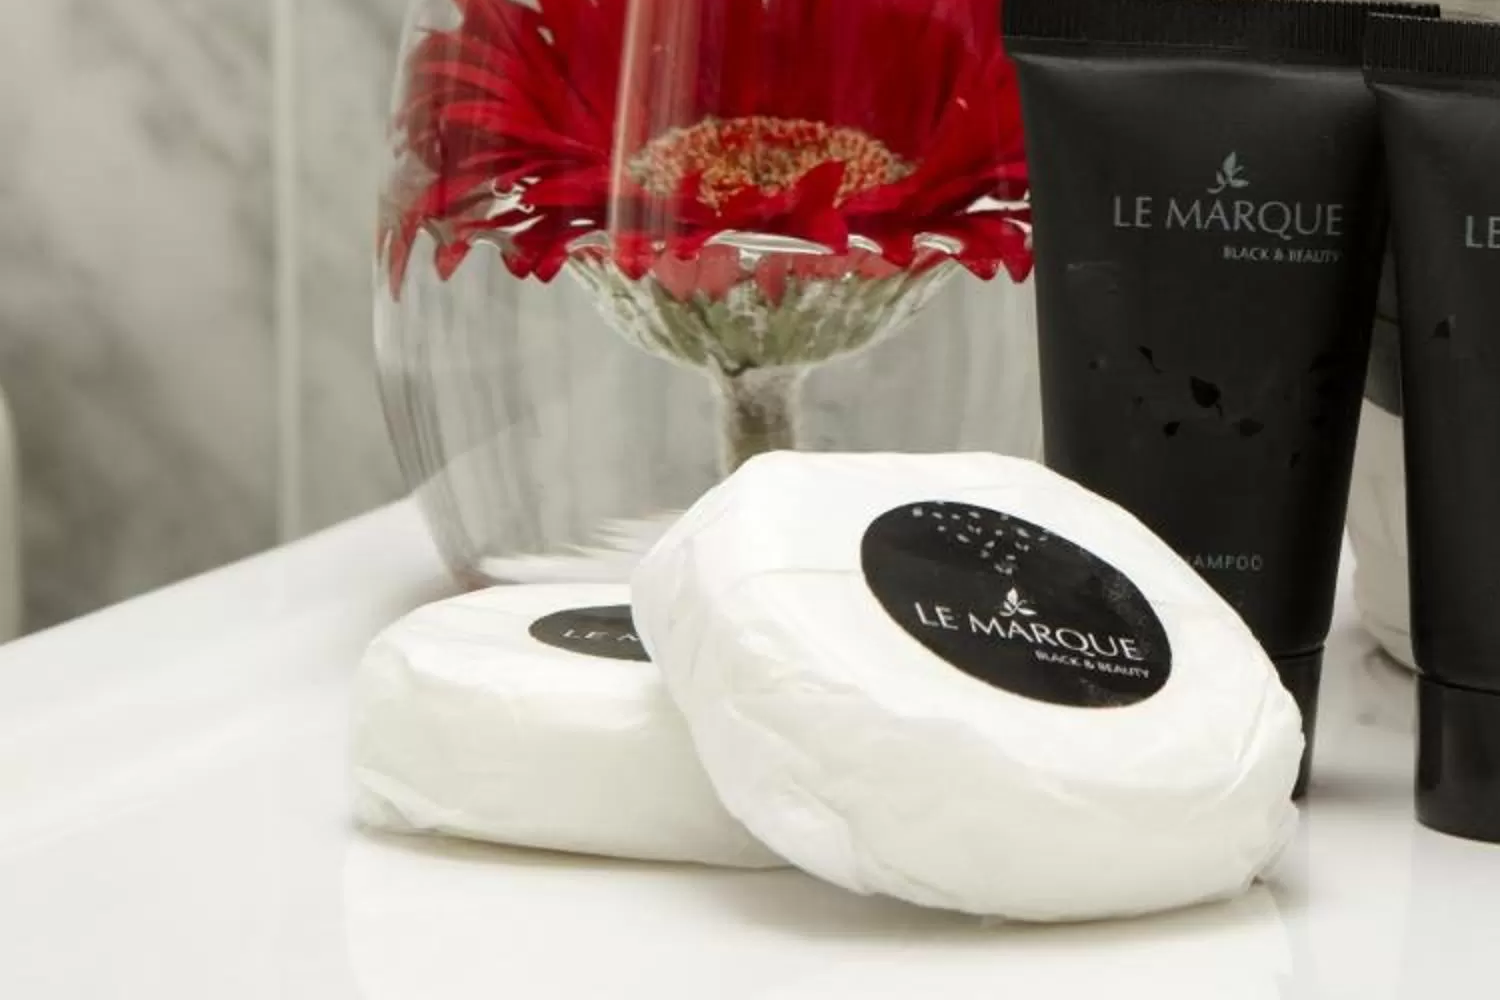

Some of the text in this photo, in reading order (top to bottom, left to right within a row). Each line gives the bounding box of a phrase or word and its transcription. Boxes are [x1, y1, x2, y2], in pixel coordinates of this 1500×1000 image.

[1112, 195, 1345, 241] LE MARQUE
[1223, 246, 1269, 261] BLACK
[1289, 248, 1339, 264] BEAUTY
[1188, 554, 1265, 572] AMPOO
[914, 601, 1146, 662] LE MARQUE
[1034, 649, 1080, 667] BLACK
[1097, 659, 1151, 680] BEAUTY
